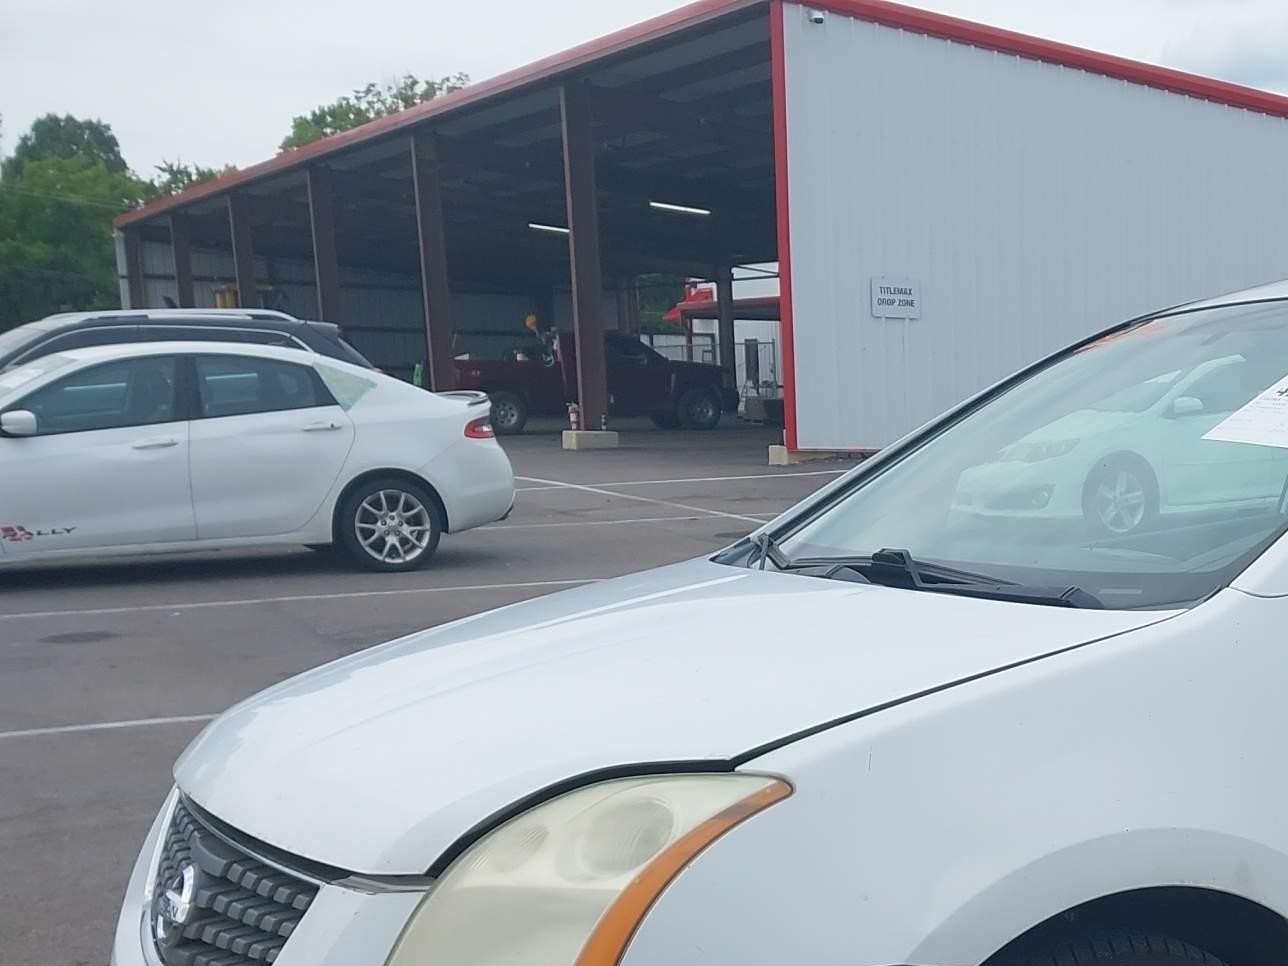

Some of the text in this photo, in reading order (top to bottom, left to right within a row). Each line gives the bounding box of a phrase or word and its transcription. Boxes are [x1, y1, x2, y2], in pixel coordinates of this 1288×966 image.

[879, 286, 913, 296] TITLEMAX
[877, 297, 915, 307] DROP ZONE
